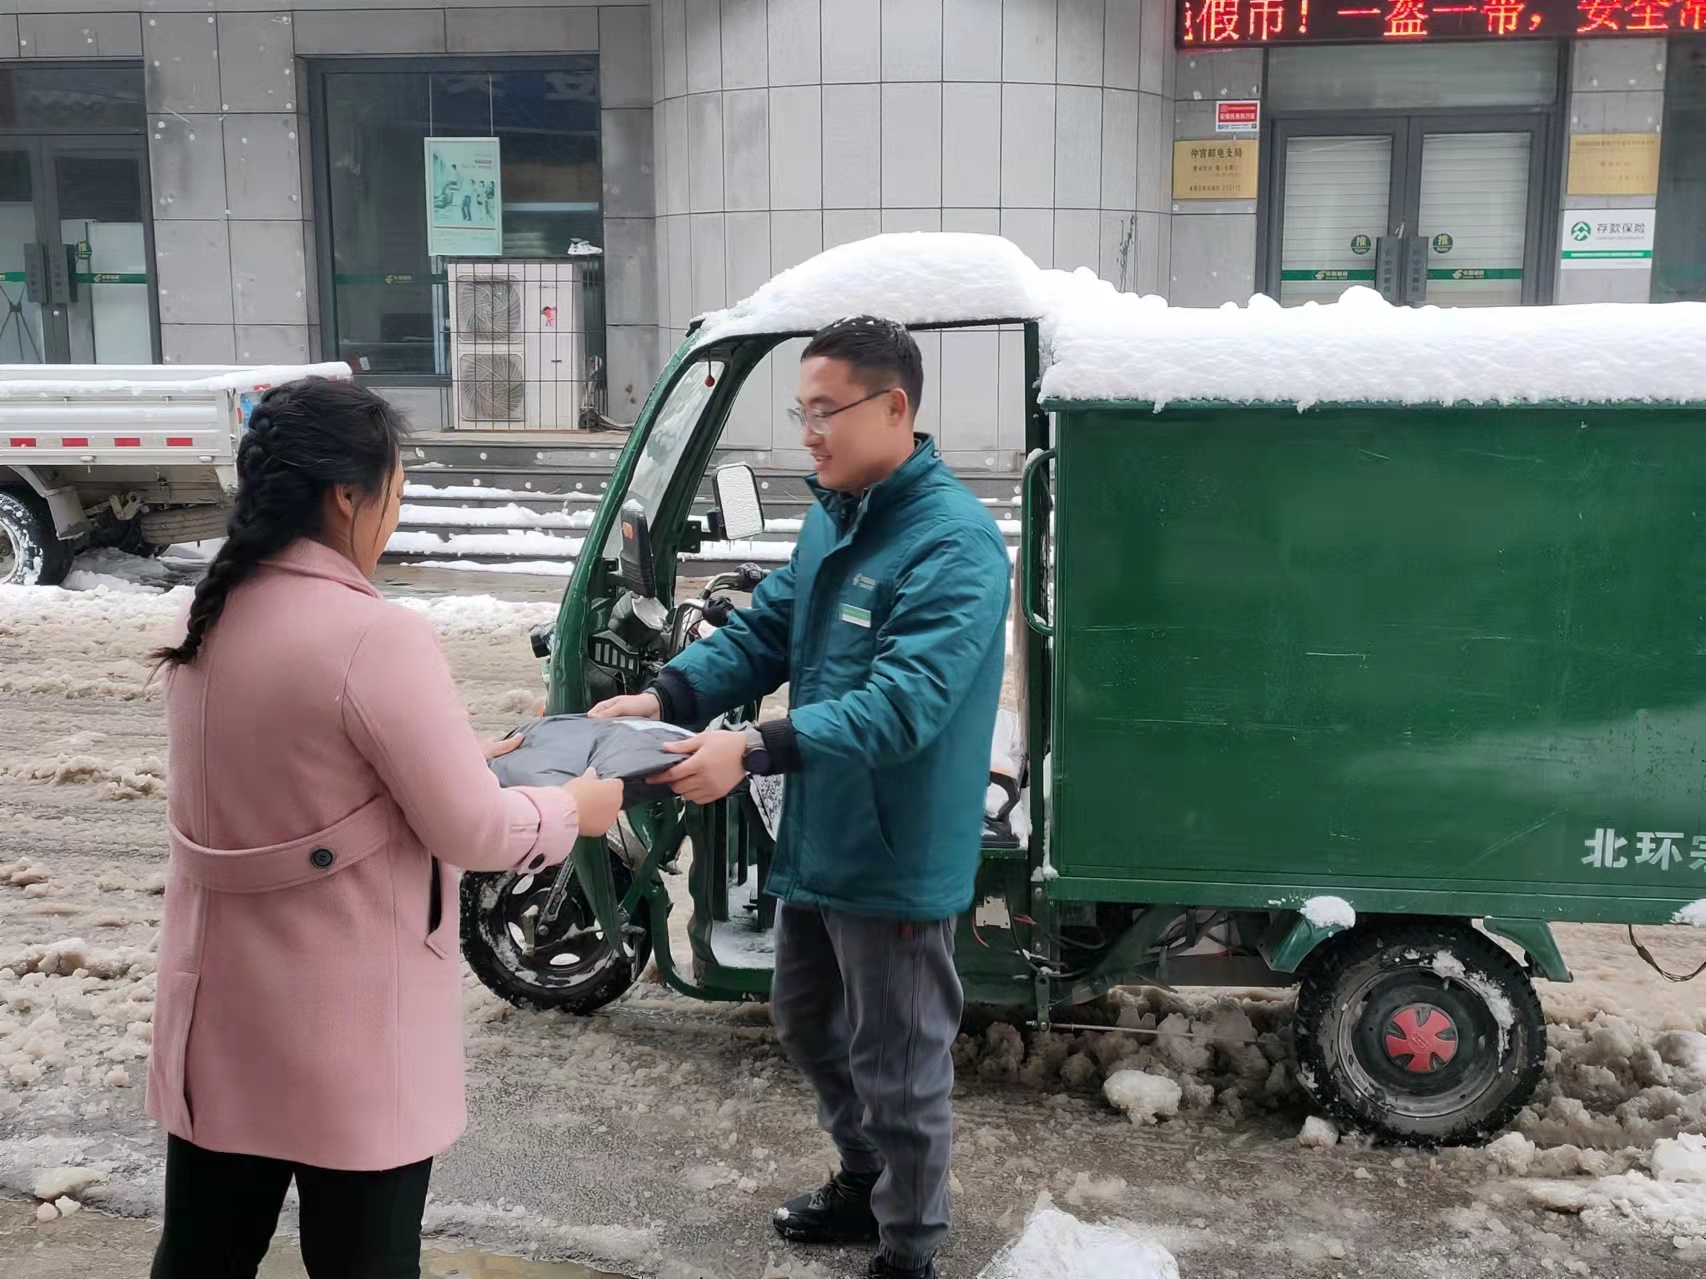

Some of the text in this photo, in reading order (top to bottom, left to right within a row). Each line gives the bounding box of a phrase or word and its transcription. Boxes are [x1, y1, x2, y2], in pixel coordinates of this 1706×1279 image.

[1597, 223, 1645, 234] 存款保险
[1356, 236, 1367, 246] 推
[1438, 235, 1448, 246] 推
